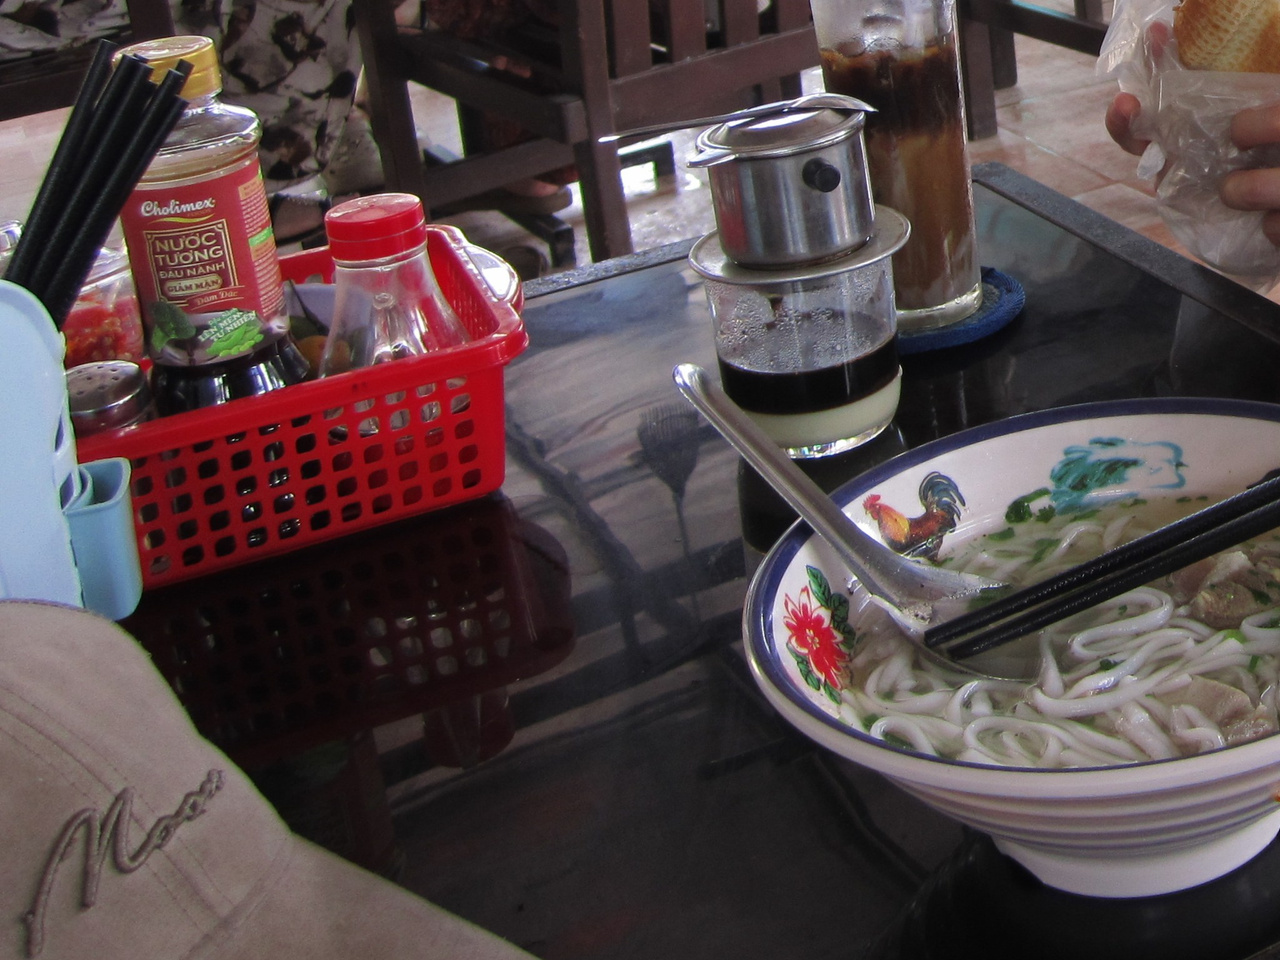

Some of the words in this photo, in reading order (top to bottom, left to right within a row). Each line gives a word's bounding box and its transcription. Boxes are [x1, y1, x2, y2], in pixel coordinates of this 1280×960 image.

[141, 197, 215, 217] Cholimex
[156, 231, 217, 252] NƯỚC
[155, 245, 223, 266] TƯƠNG
